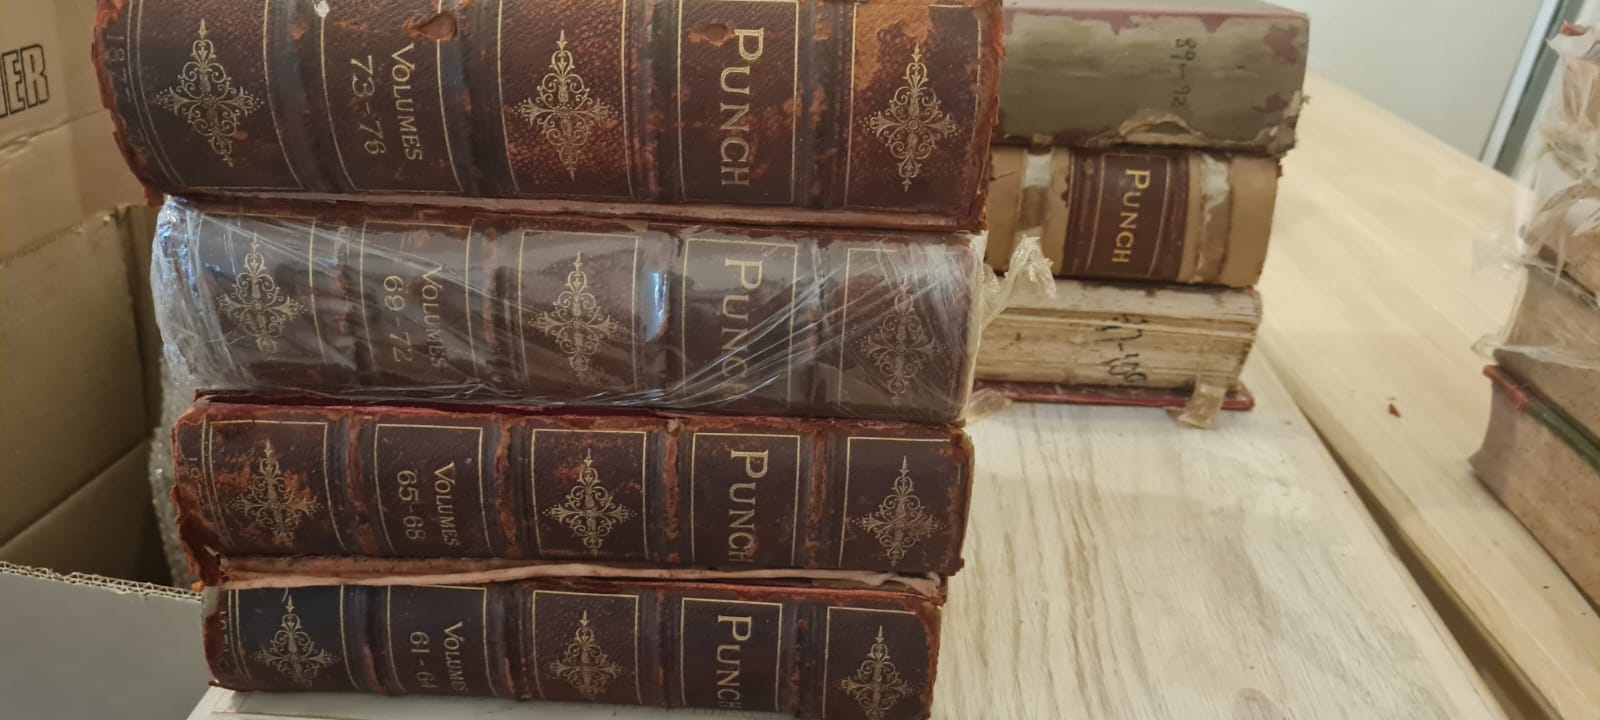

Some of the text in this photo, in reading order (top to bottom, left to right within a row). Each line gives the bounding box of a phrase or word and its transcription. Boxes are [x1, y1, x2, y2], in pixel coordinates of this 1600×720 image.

[0, 44, 50, 118] ER
[350, 55, 386, 155] 73-76
[391, 42, 423, 160] VOLUMES
[719, 26, 764, 186] PUNCH
[1111, 168, 1151, 263] PUNCH
[383, 275, 413, 362] 69-72
[421, 265, 447, 368] VOLUMES
[721, 257, 763, 398] PUNCH
[396, 470, 426, 540] 65-68
[433, 461, 461, 546] VOLUMES
[728, 449, 769, 562] PUNCH
[716, 614, 752, 709] PUNCH
